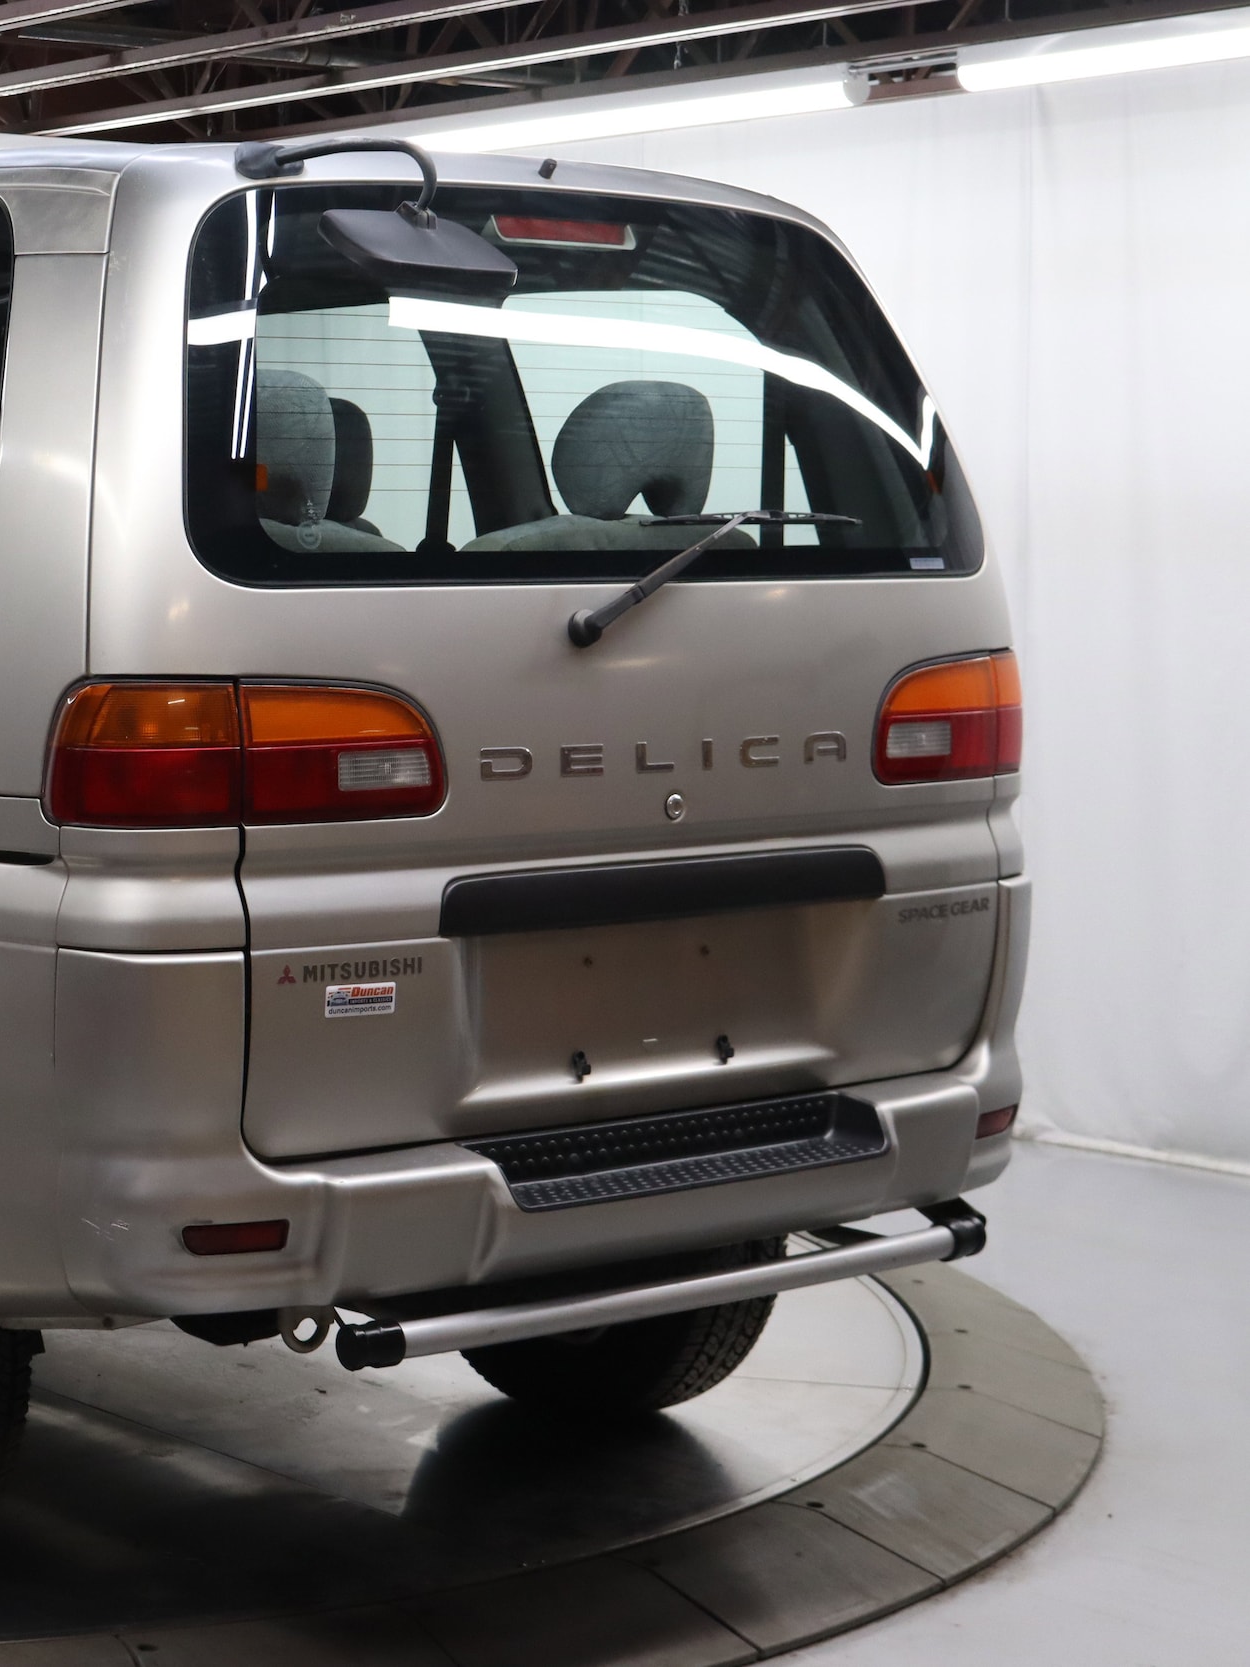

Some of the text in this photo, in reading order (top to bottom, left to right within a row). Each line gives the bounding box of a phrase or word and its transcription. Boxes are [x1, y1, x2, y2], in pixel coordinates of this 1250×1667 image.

[480, 731, 847, 781] DELICA
[898, 898, 990, 923] SPACE GEAR
[303, 957, 423, 983] MITSUBISHI
[351, 986, 394, 998] Duncan
[328, 1005, 391, 1015] duncanimports.com
